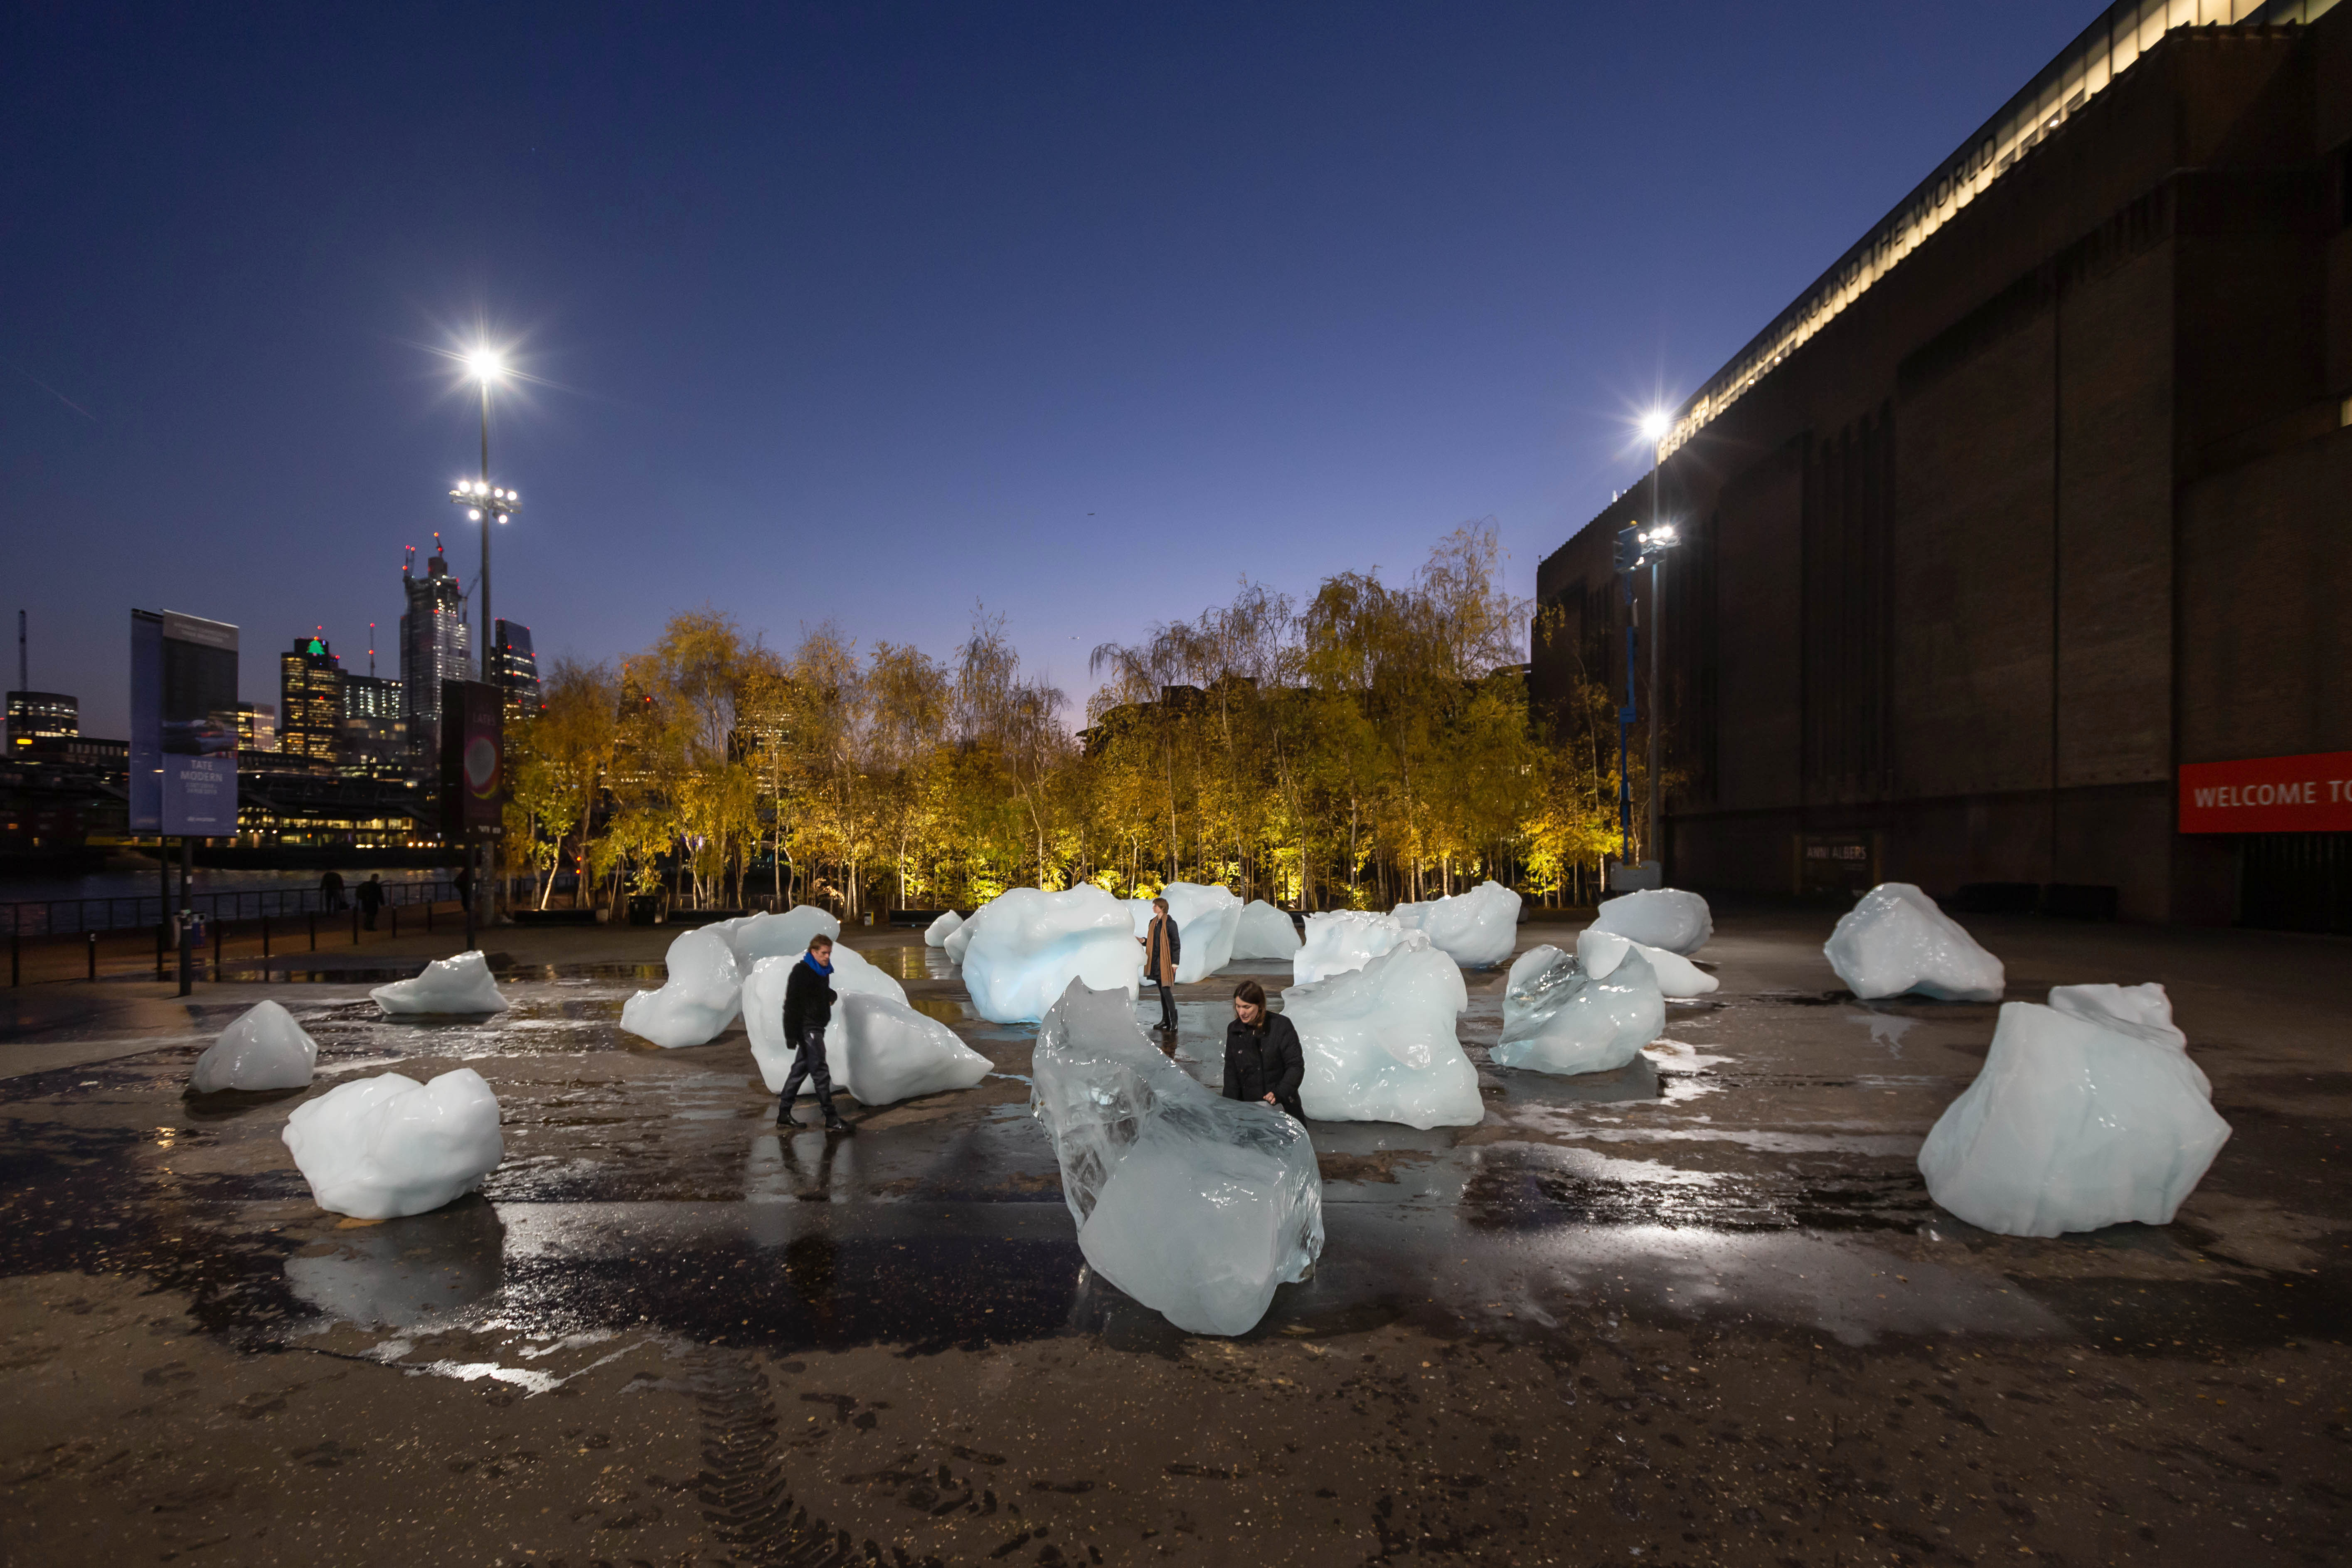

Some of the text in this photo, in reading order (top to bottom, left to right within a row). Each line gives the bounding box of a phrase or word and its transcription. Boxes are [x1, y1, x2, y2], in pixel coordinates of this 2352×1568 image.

[1789, 254, 1860, 338] AROUND
[1867, 214, 1904, 266] THE
[1913, 134, 1996, 228] WORLD
[191, 760, 213, 770] TATE
[180, 771, 223, 781] MODERN
[2194, 782, 2316, 807] WELCOME
